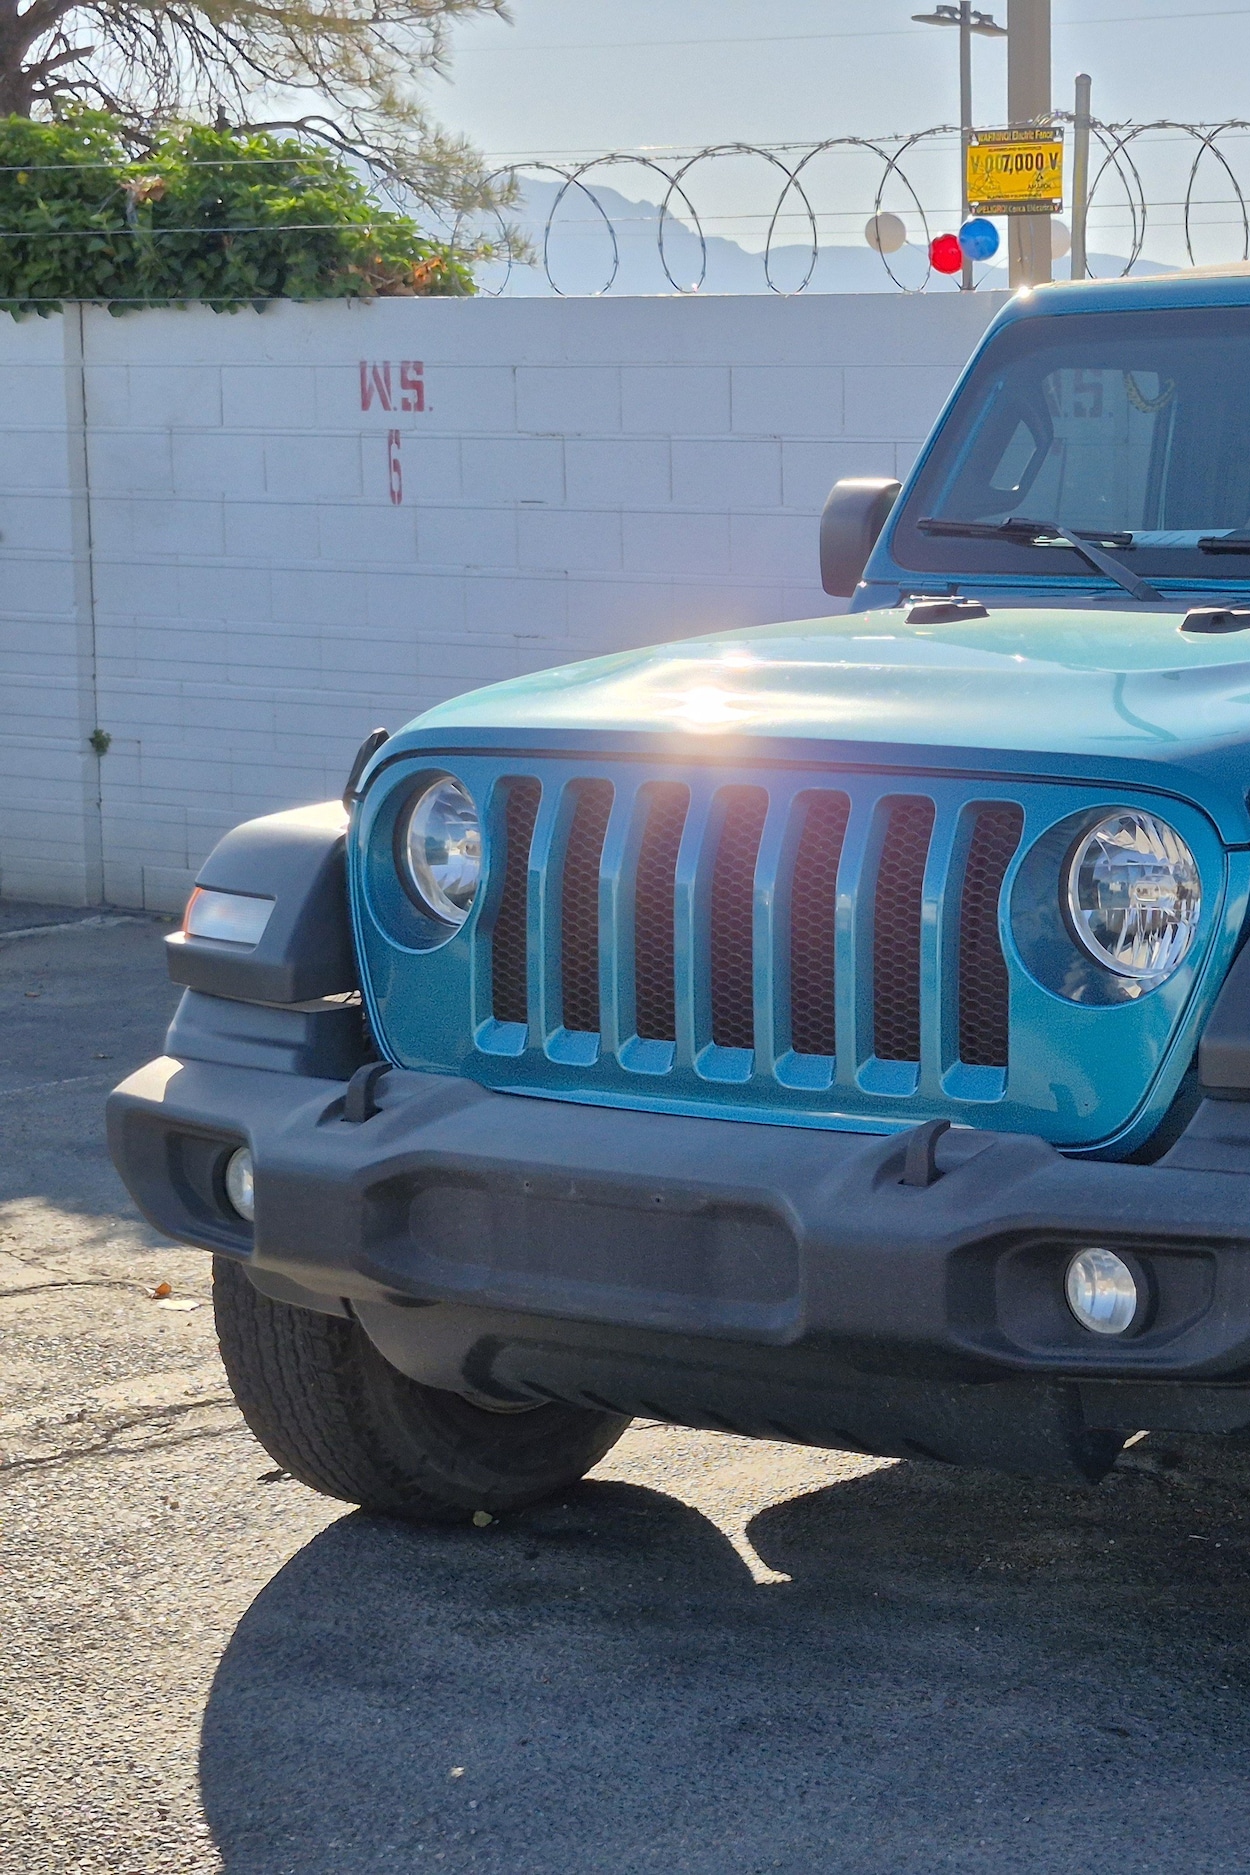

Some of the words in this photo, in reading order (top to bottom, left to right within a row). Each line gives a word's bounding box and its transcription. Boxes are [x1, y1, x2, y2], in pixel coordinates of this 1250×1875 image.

[1002, 152, 1044, 174] 7,000
[1049, 152, 1058, 170] V
[359, 360, 433, 412] W.S.
[388, 429, 403, 505] 6
